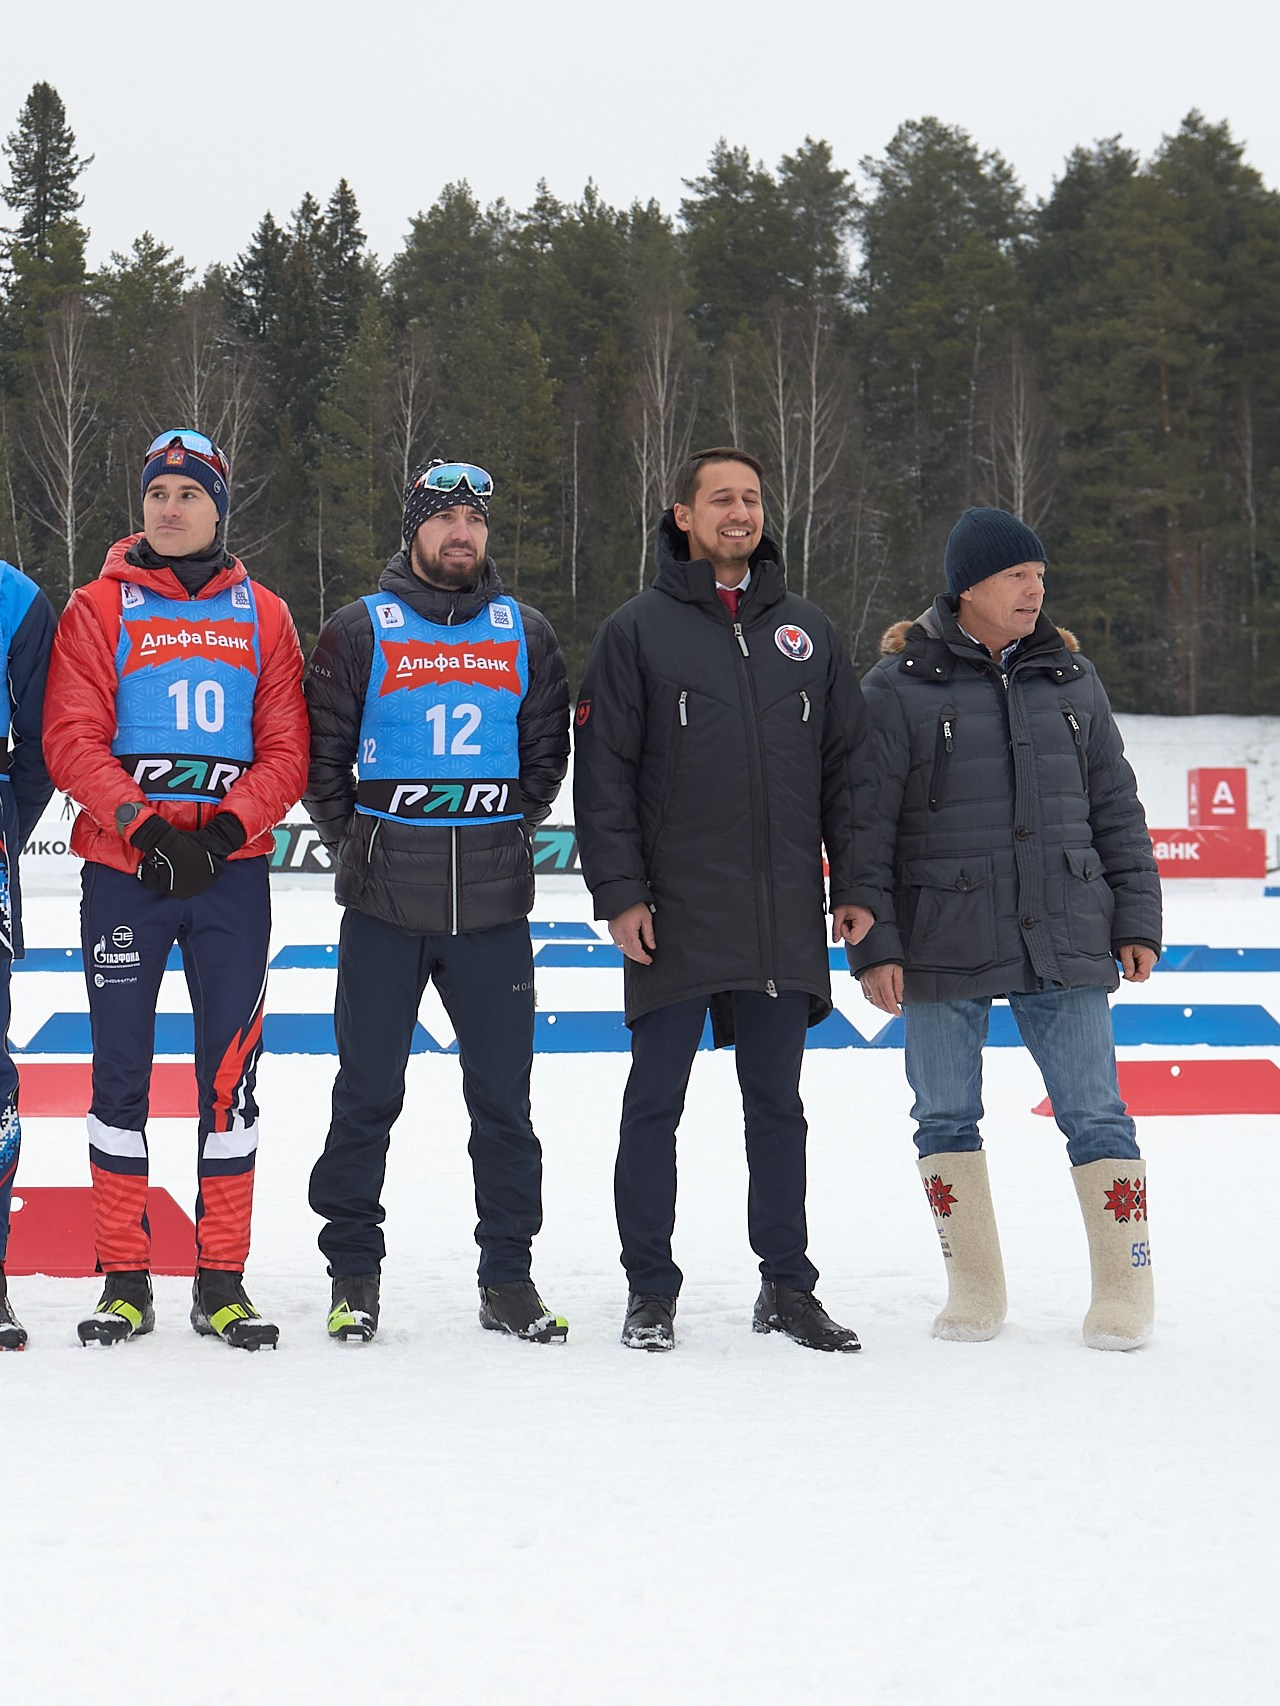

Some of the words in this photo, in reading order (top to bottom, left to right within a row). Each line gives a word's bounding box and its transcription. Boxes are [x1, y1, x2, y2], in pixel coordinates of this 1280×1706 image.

[141, 630, 202, 650] Альфа
[205, 631, 249, 651] Банк
[397, 654, 460, 673] Альфа
[463, 654, 510, 672] Банк
[168, 679, 225, 733] 10
[425, 703, 482, 756] 12
[363, 738, 377, 763] 12
[133, 759, 246, 793] PAR
[388, 783, 509, 813] PARI
[23, 841, 70, 855] ИКО
[1153, 842, 1200, 860] анк
[1131, 1242, 1147, 1268] 55
